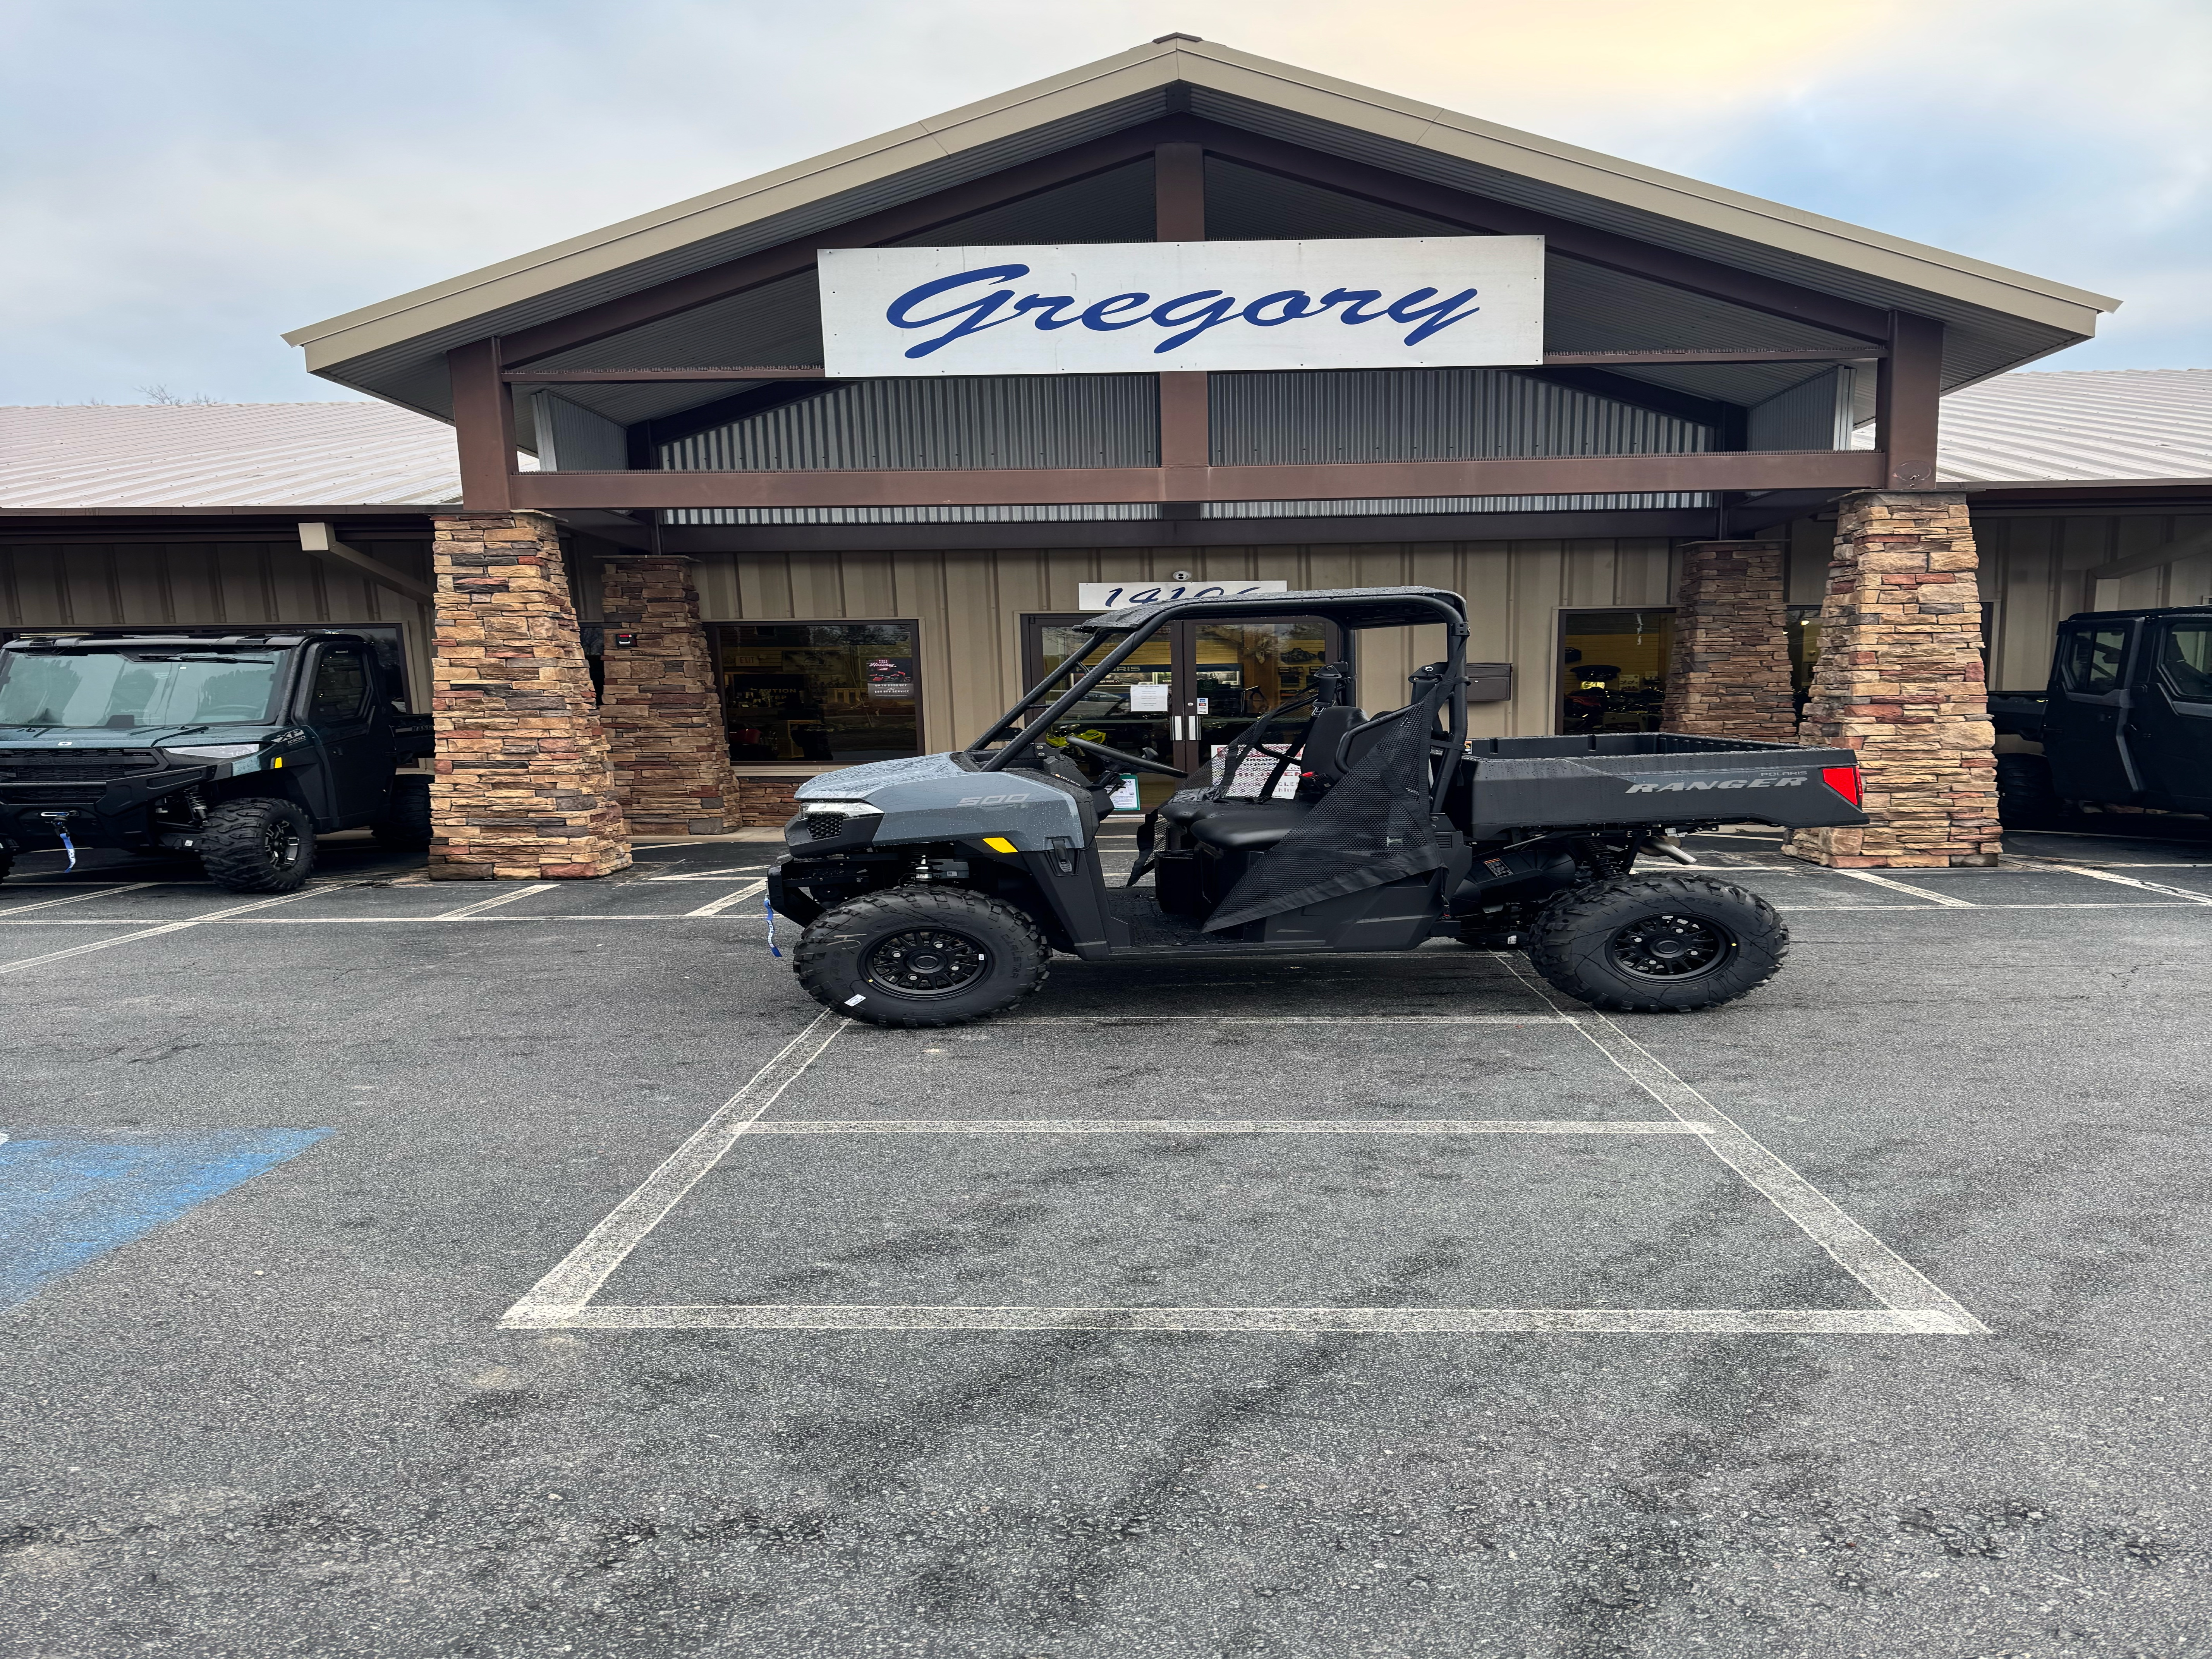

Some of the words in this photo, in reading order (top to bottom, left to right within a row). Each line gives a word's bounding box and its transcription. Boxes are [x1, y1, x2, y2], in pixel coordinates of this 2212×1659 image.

[886, 263, 1480, 359] Gregory
[277, 729, 302, 742] XP
[287, 735, 306, 745] 1000
[1625, 777, 1808, 794] RANGER
[957, 793, 1031, 807] 500
[766, 920, 775, 948] POLARIS
